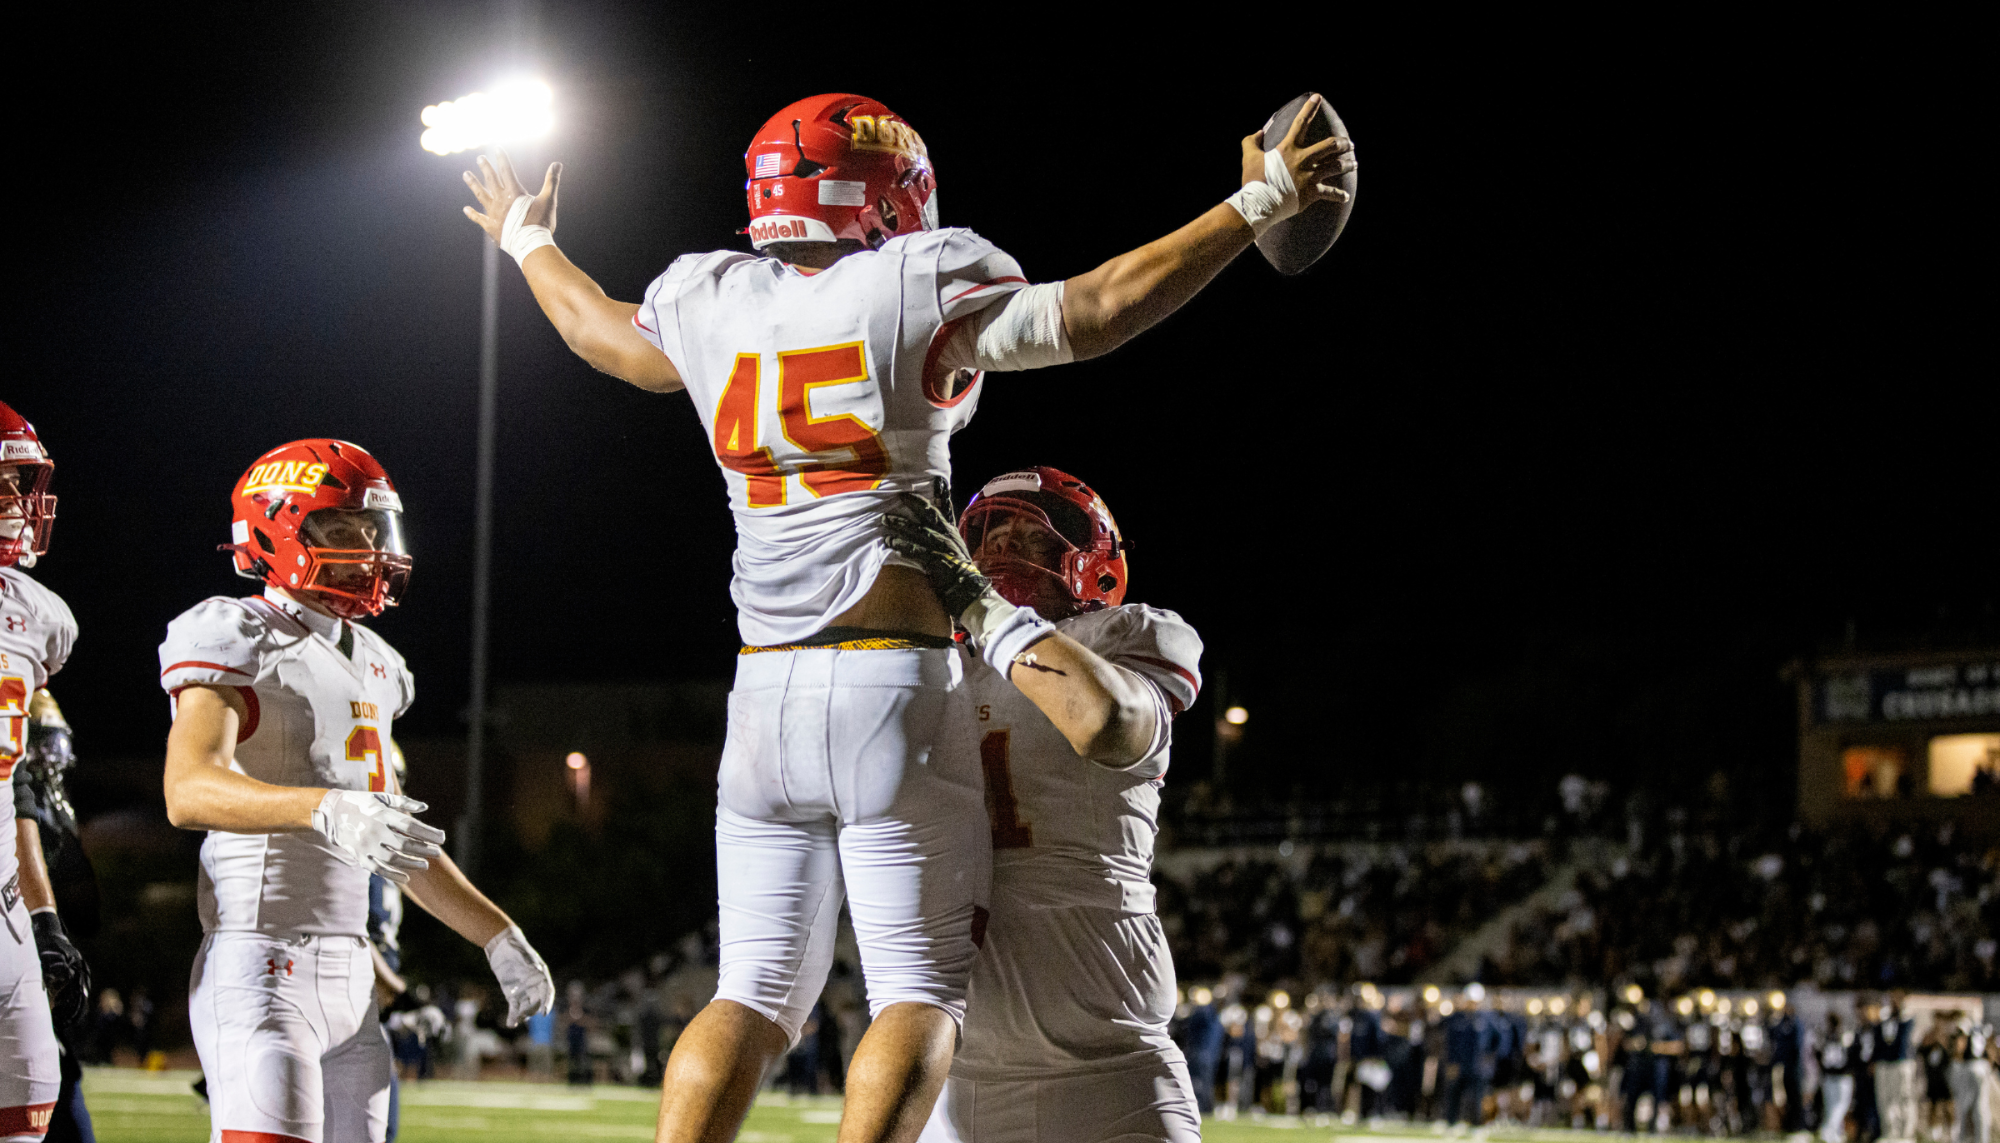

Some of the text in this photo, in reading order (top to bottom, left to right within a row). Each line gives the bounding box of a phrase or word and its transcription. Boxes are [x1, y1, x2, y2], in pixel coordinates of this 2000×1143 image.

[772, 184, 783, 196] 45
[714, 340, 892, 508] 45
[246, 460, 327, 488] DONS
